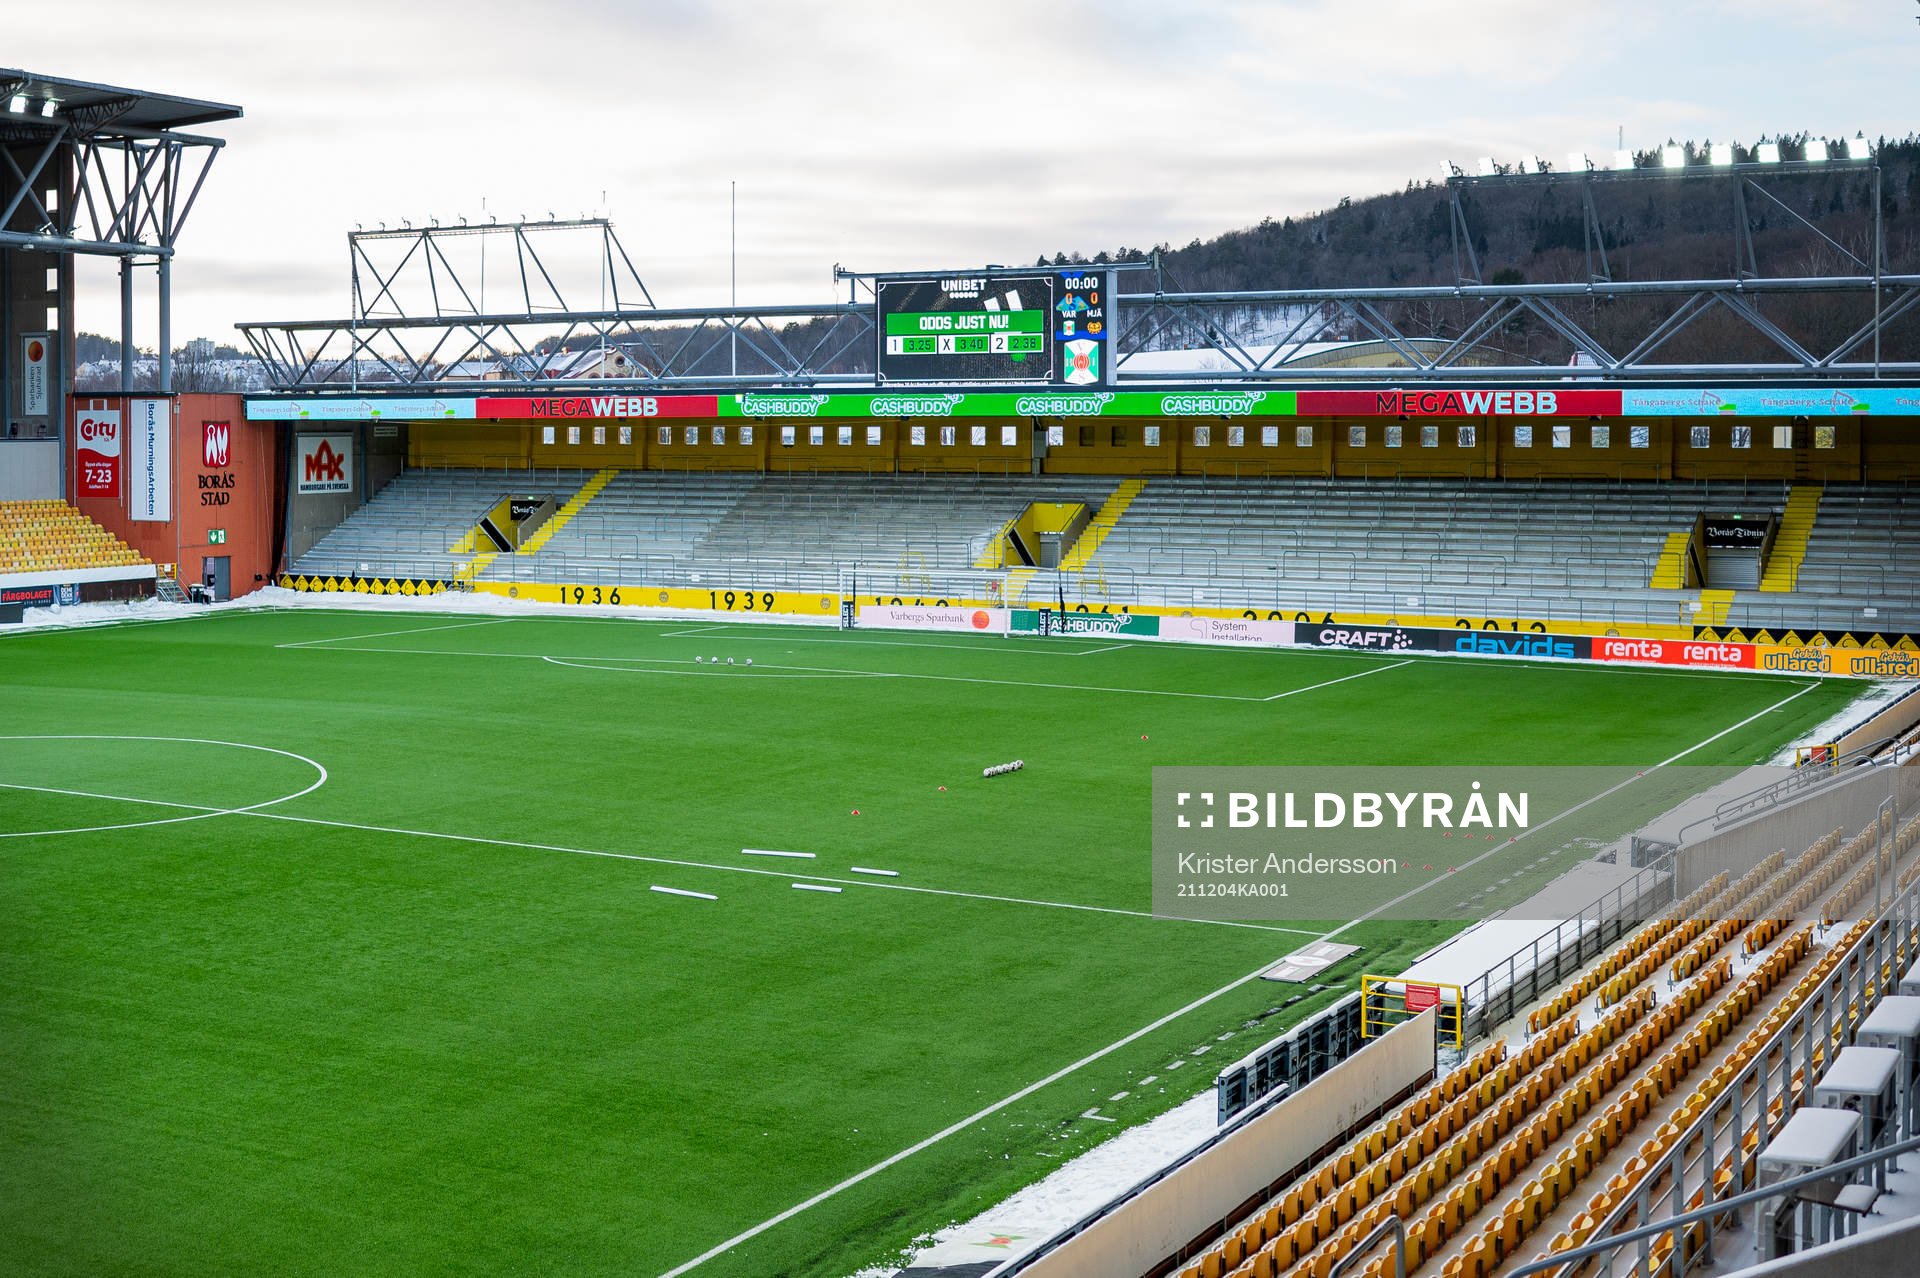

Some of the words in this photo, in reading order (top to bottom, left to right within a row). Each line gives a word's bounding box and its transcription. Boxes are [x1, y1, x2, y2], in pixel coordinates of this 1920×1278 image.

[941, 279, 986, 292] UNIBET
[1065, 277, 1098, 289] 00:00
[1065, 293, 1073, 304] 0
[1090, 292, 1098, 304] 0
[920, 316, 951, 330] ODDS
[954, 315, 986, 329] JUST
[989, 314, 1009, 328] NU!
[908, 339, 931, 350] 3.25
[943, 338, 950, 350] X
[960, 338, 983, 350] 3.40
[996, 338, 1003, 350] 2
[1012, 337, 1036, 349] 2.38
[28, 367, 36, 410] Sparbanken
[531, 398, 658, 416] MEGAWEBB
[743, 401, 817, 414] CASHBUDDY
[872, 399, 953, 414] CASHBUDDY
[1018, 399, 1101, 413] CASHBUDDY
[1164, 398, 1253, 413] CASHBUDDY
[1377, 392, 1557, 414] MEGAWEBB
[147, 403, 155, 431] Borås
[80, 418, 117, 441] City
[305, 438, 344, 482] MAX
[85, 469, 111, 483] 7-23
[147, 433, 155, 516] MurningsArbeten
[198, 471, 235, 489] BORÅS
[201, 492, 230, 506] STAD
[1706, 526, 1734, 537] Borås
[2, 590, 53, 602] FÄRGBOLAGET
[560, 586, 621, 605] 1936
[710, 591, 774, 611] 1939
[890, 610, 925, 623] Varbergs
[926, 612, 965, 624] Sparbank
[1050, 619, 1119, 633] ASHBUDDY
[1212, 620, 1248, 632] System
[1319, 629, 1392, 647] CRAFT
[1456, 632, 1575, 659] davids
[1605, 640, 1663, 658] renta
[1683, 644, 1742, 662] renta
[1792, 648, 1822, 659] Gekås
[1880, 651, 1911, 662] Gekås
[1765, 653, 1831, 672] Ullared
[1851, 656, 1919, 676] Ullared
